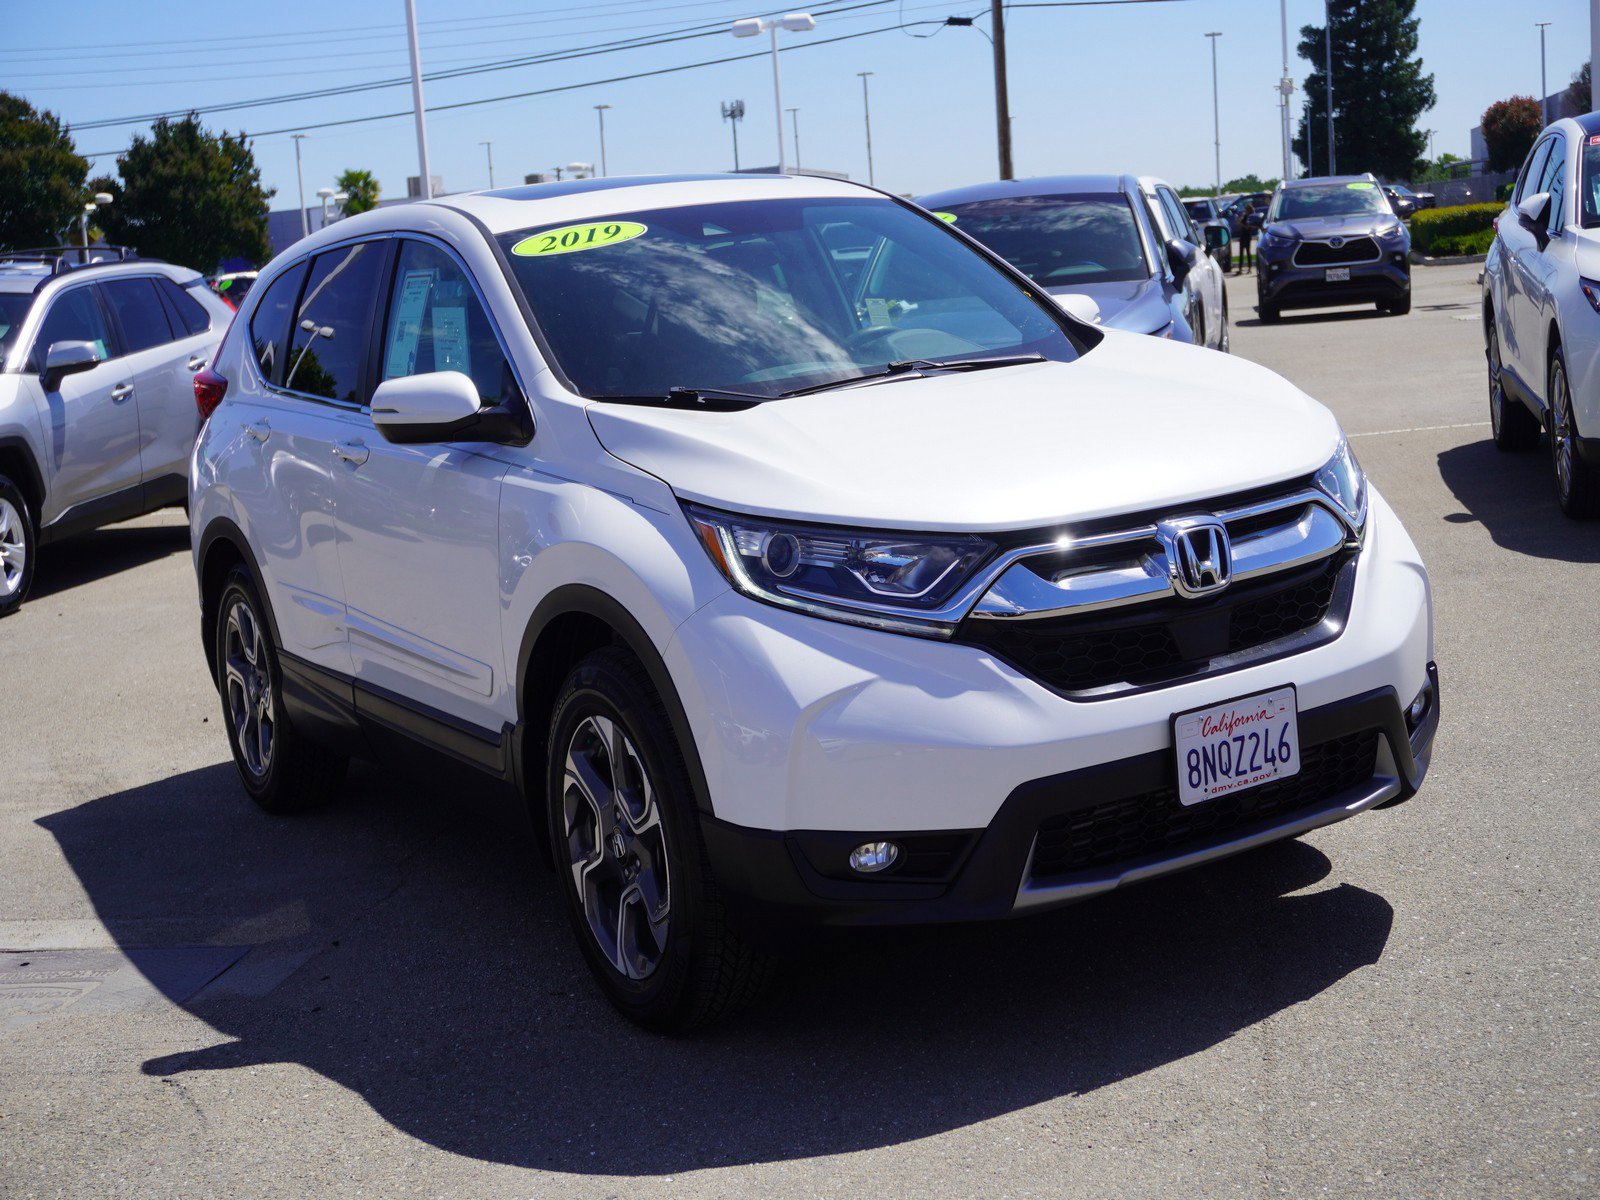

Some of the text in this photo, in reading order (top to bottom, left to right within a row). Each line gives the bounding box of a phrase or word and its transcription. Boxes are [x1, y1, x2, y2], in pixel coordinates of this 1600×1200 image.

[539, 224, 622, 253] 2019
[1202, 706, 1275, 738] California
[1186, 721, 1291, 789] 8NQZ246
[1211, 772, 1272, 794] dmv.ca.gov
